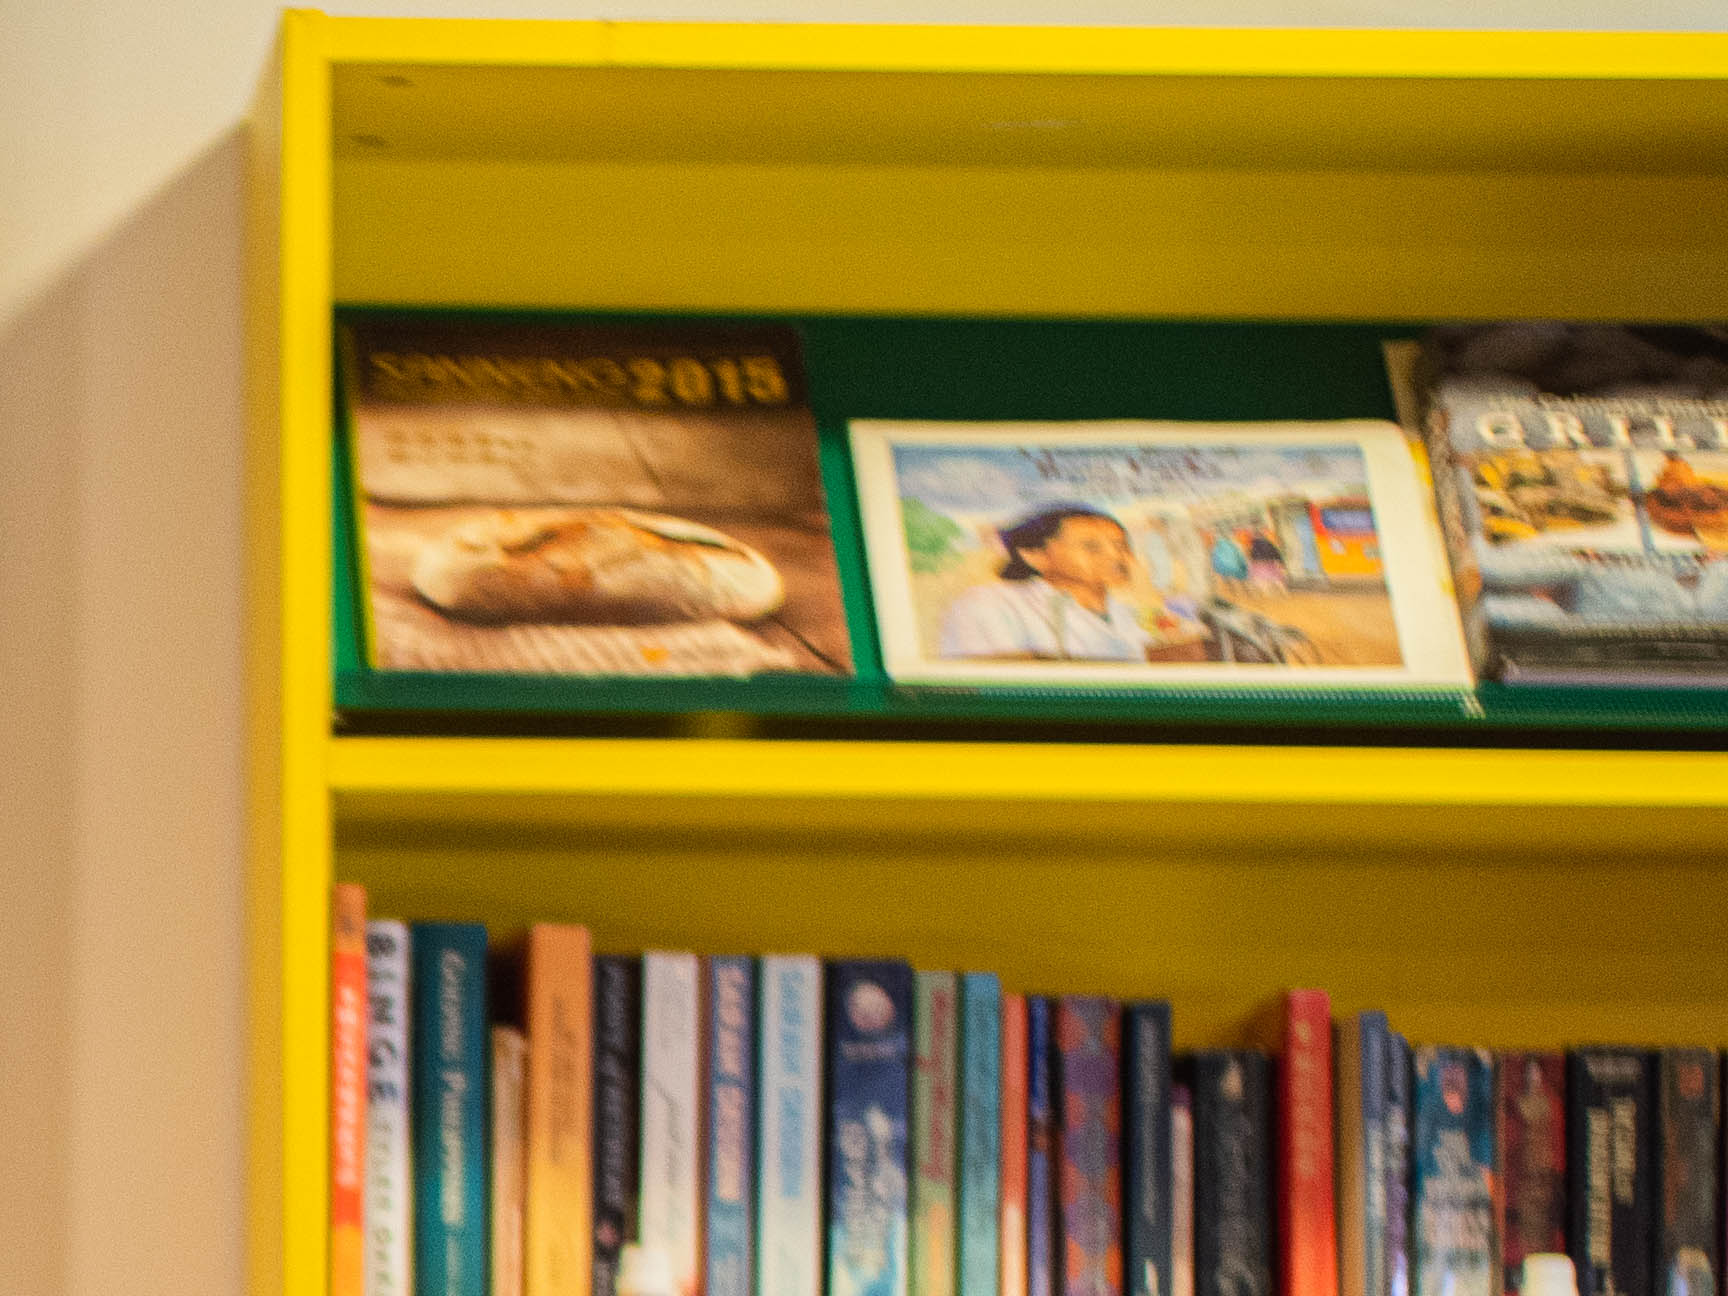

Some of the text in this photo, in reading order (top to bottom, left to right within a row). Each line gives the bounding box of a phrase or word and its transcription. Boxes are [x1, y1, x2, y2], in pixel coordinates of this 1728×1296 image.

[627, 356, 788, 405] 2015
[1476, 408, 1728, 448] GRIL
[369, 932, 397, 1104] BINGE
